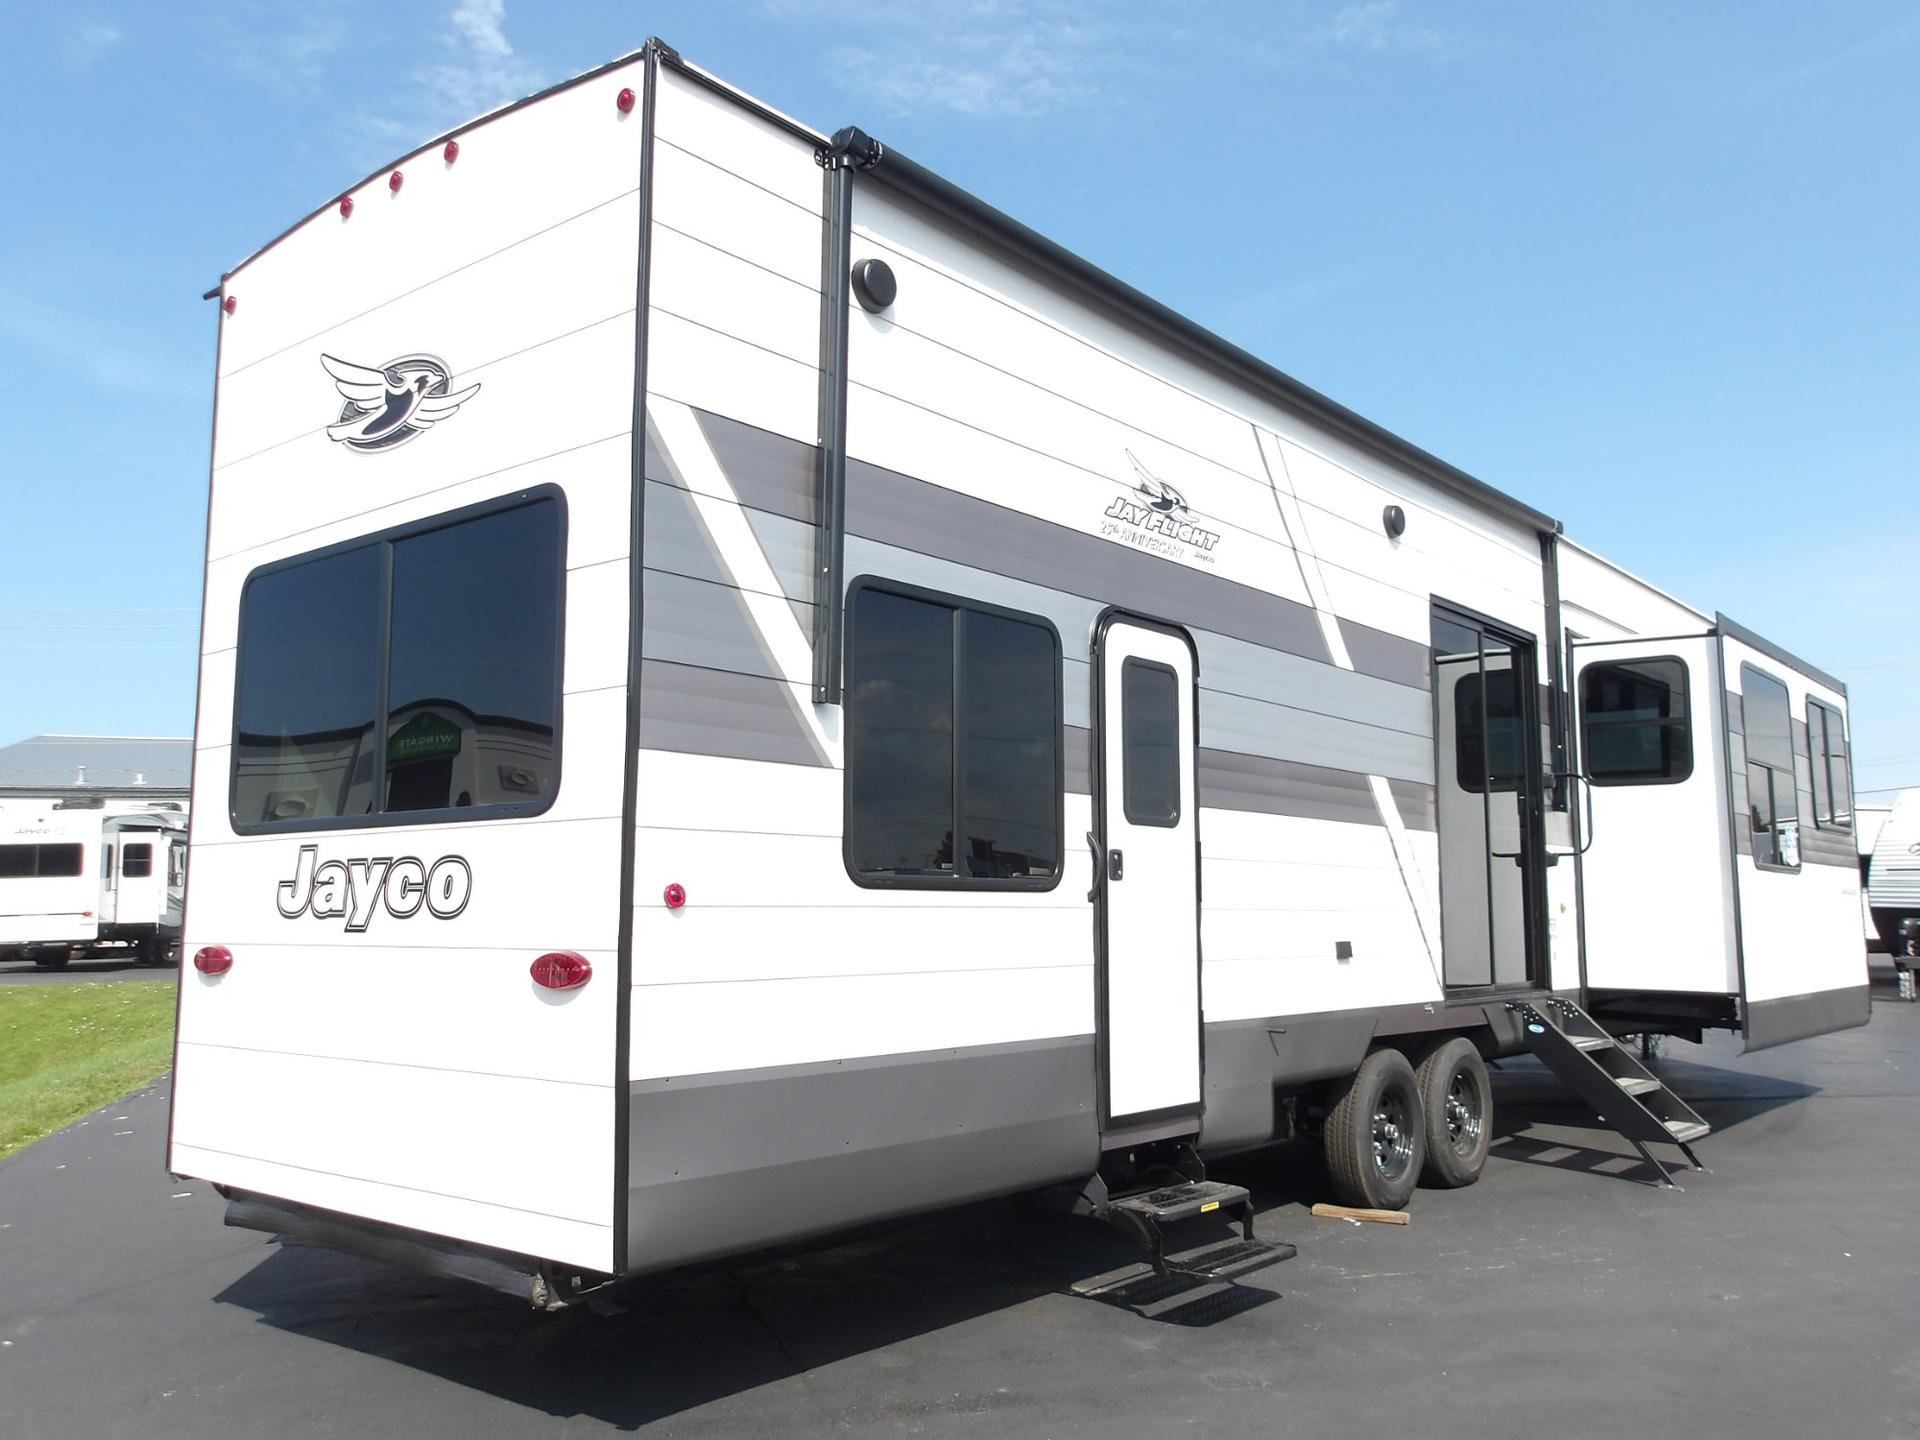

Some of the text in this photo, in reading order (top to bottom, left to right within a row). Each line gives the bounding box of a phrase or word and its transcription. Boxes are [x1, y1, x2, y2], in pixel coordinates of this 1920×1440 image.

[1104, 496, 1220, 551] JAY FLIGHT
[276, 844, 472, 933] Jayco
